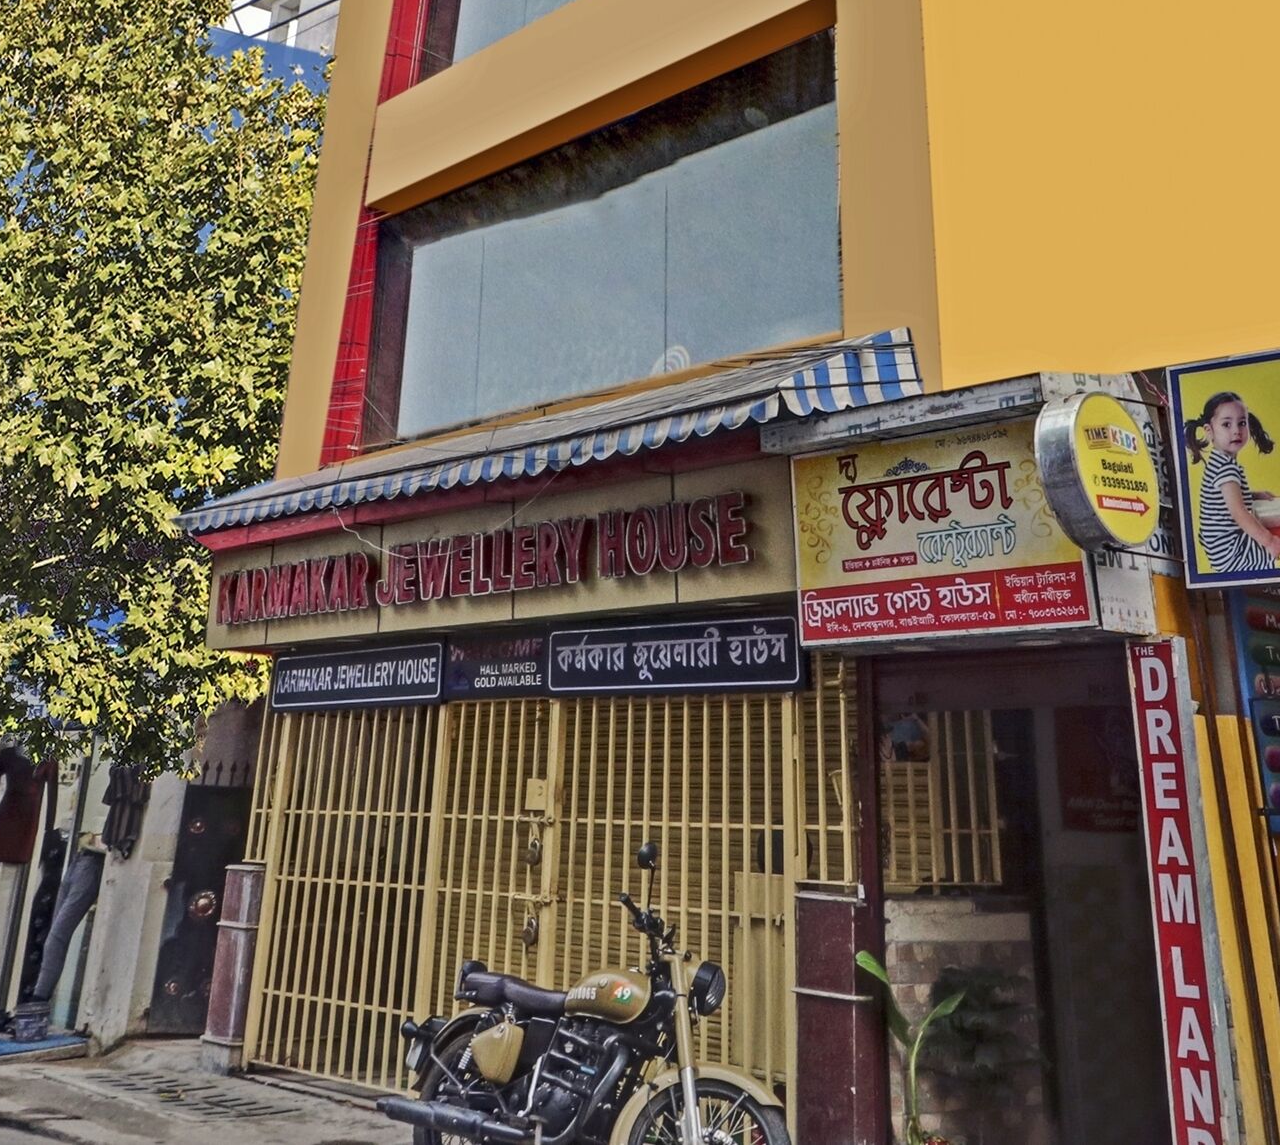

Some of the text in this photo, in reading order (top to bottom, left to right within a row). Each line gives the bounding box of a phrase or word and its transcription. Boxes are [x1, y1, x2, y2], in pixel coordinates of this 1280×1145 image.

[1084, 426, 1108, 441] TIME
[1101, 459, 1134, 475] Baguiati
[1101, 477, 1149, 493] 9339531850
[216, 489, 750, 625] KARMAKAR JEWELLERY HOUSE
[884, 582, 931, 616] গেস্ট
[935, 577, 992, 609] হাউস
[556, 625, 788, 682] কর্মকার জুয়েলারী হাউস
[1134, 646, 1155, 656] THE
[276, 657, 437, 694] KARMAKAR JEWELLERY HOUSE
[480, 662, 537, 675] HALL MARKED
[474, 674, 542, 688] GOLD AVAILABLE
